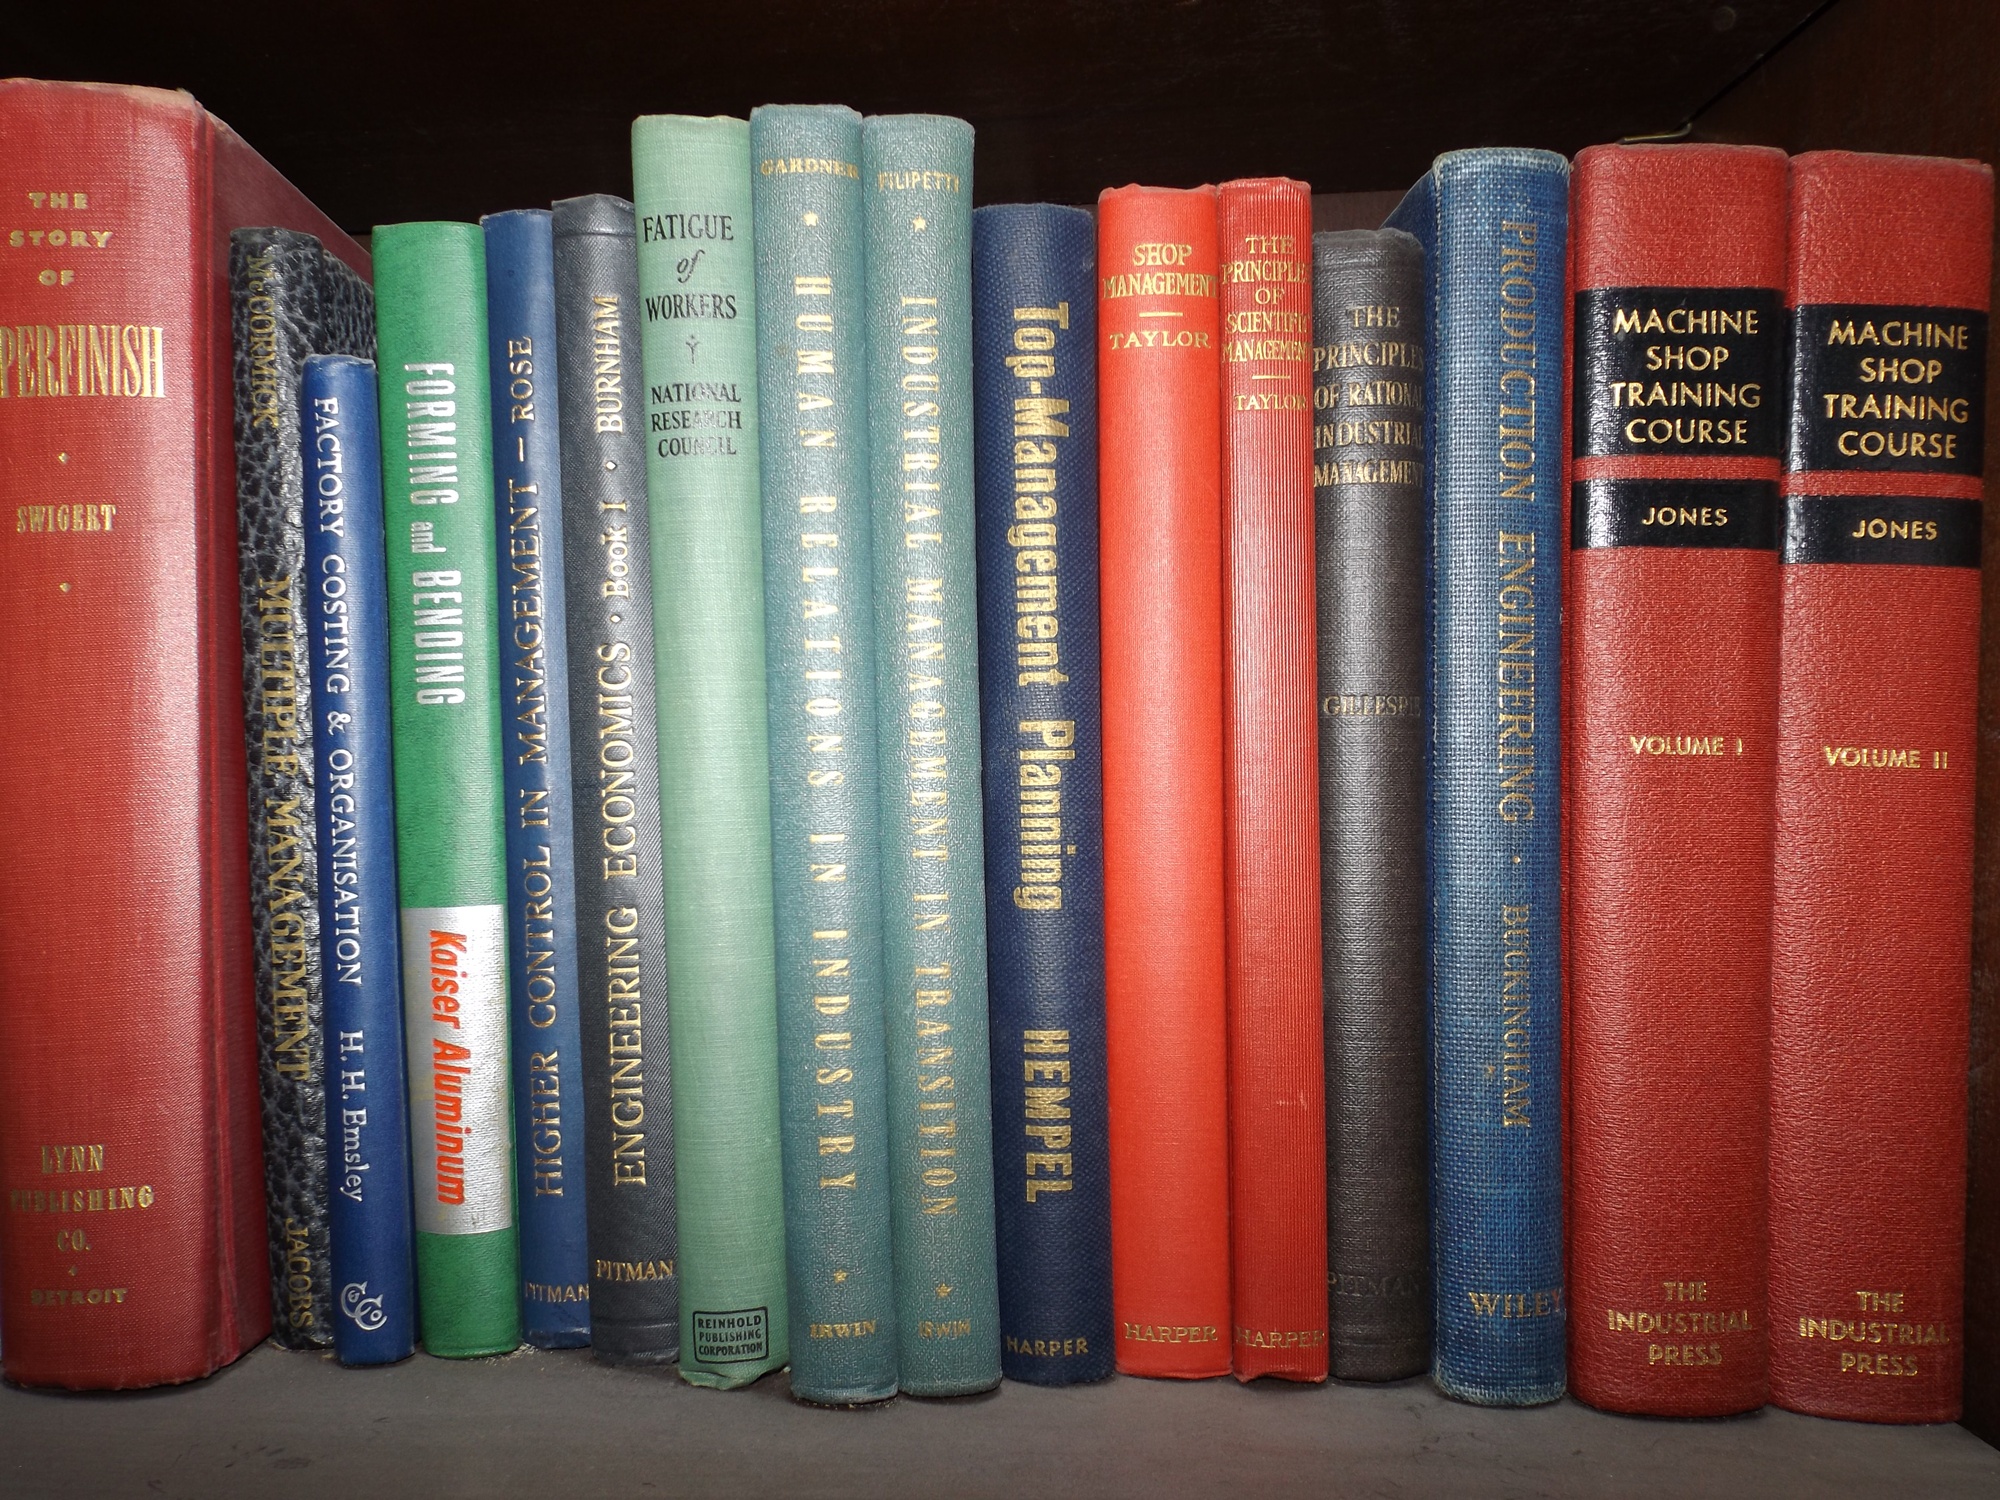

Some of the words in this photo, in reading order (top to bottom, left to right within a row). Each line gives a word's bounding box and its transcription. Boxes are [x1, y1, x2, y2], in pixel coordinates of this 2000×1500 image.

[761, 157, 859, 180] GARDNER
[877, 170, 960, 193] FILIPETTI
[29, 193, 88, 209] THE
[10, 230, 113, 248] STORY
[643, 213, 735, 243] FATIGUE
[1132, 243, 1192, 266] SHOP
[1246, 234, 1296, 254] THE
[38, 269, 75, 286] OF
[676, 249, 706, 283] of
[1102, 272, 1219, 299] MANAGEMENT
[1254, 288, 1285, 305] OF
[645, 293, 737, 323] WORKERS
[1351, 305, 1400, 328] THE
[1613, 308, 1759, 335] MACHINE
[1110, 331, 1211, 351] TAYLOR
[1827, 319, 1969, 350] MACHINE
[591, 295, 624, 435] BURNHAM
[794, 276, 835, 449] HUMAN
[1313, 341, 1424, 371] PRINCIPLES
[1500, 220, 1537, 502] PRODUCTION
[1646, 345, 1729, 371] SHOP
[1859, 357, 1942, 384] SHOP
[508, 336, 535, 424] ROSE
[650, 381, 742, 405] NATIONAL
[1609, 381, 1761, 408] TRAINING
[1235, 394, 1307, 411] TAYLOR
[1314, 384, 1341, 410] OF
[1348, 381, 1424, 411] RATIONAL
[1823, 393, 1969, 424] TRAINING
[404, 362, 459, 506] FORMING
[651, 409, 742, 433] RESEARCH
[901, 296, 942, 549] INDUSTRIAL
[1315, 421, 1424, 450] INDUSTRIAL
[1625, 418, 1748, 444] COURSE
[658, 436, 737, 458] COUNCIL
[1838, 430, 1957, 459] COURSE
[314, 397, 345, 539] FACTORY
[1314, 459, 1425, 488] MANAGEMENT
[1005, 302, 1070, 687] Top-Management
[17, 504, 116, 533] SWIGERT
[1641, 506, 1729, 527] JONES
[1852, 518, 1938, 540] JONES
[410, 521, 447, 554] and
[601, 522, 630, 599] Book
[322, 554, 351, 694] COSTING
[508, 478, 549, 767] MANAGEMENT
[412, 570, 466, 705] BENDING
[800, 496, 844, 786] RELATIONS
[259, 575, 300, 779] MULTIPLE
[1499, 532, 1535, 823] ENGINEERING
[327, 710, 352, 736] &
[905, 578, 949, 862] MANAGEMENT
[597, 641, 637, 880] ECONOMICS
[1630, 736, 1724, 756] VOLUME
[1736, 737, 1744, 756] I
[1824, 746, 1921, 769] VOLUME
[1932, 750, 1949, 769] II
[520, 789, 549, 830] IN
[1013, 720, 1077, 910] Planning
[328, 749, 362, 986] ORGANISATION
[809, 833, 847, 883] IN
[912, 893, 951, 931] IN
[265, 798, 311, 1082] MANAGEMENT
[523, 845, 557, 1029] CONTROL
[429, 930, 468, 1029] Kaiser
[1502, 903, 1532, 1128] BUCKINGHAM
[339, 1030, 364, 1062] H.
[604, 905, 647, 1187] ENGINEERING
[812, 929, 859, 1189] INDUSTRY
[340, 1069, 366, 1100] H.
[914, 961, 958, 1216] TRANSITION
[433, 1038, 472, 1206] Aluminum
[530, 1049, 563, 1198] HIGHER
[1024, 1029, 1073, 1203] HEMPEL
[41, 1144, 104, 1174] LYNN
[340, 1107, 368, 1202] Emsley
[10, 1185, 154, 1212] PUBLISHING
[57, 1228, 92, 1252] CO.
[284, 1217, 313, 1329] JACOBS
[596, 1259, 674, 1282] PITMAN
[31, 1288, 127, 1305] DETROIT
[524, 1281, 590, 1303] PITMAN
[1468, 1288, 1564, 1319] WILEY
[1663, 1281, 1707, 1301] THE
[1857, 1291, 1904, 1313] THE
[698, 1315, 762, 1329] REINHOLD
[699, 1328, 761, 1343] PUBLISHING
[810, 1319, 877, 1339] IRWIN
[1124, 1322, 1218, 1343] HARPER
[1608, 1309, 1752, 1334] INDUSTRIAL
[1799, 1316, 1950, 1345] INDUSTRIAL
[698, 1342, 763, 1356] CORPORATION
[1006, 1335, 1089, 1357] HARPER
[1235, 1326, 1325, 1348] HARPER
[1649, 1343, 1722, 1365] PRESS
[1841, 1352, 1918, 1376] PRESS
